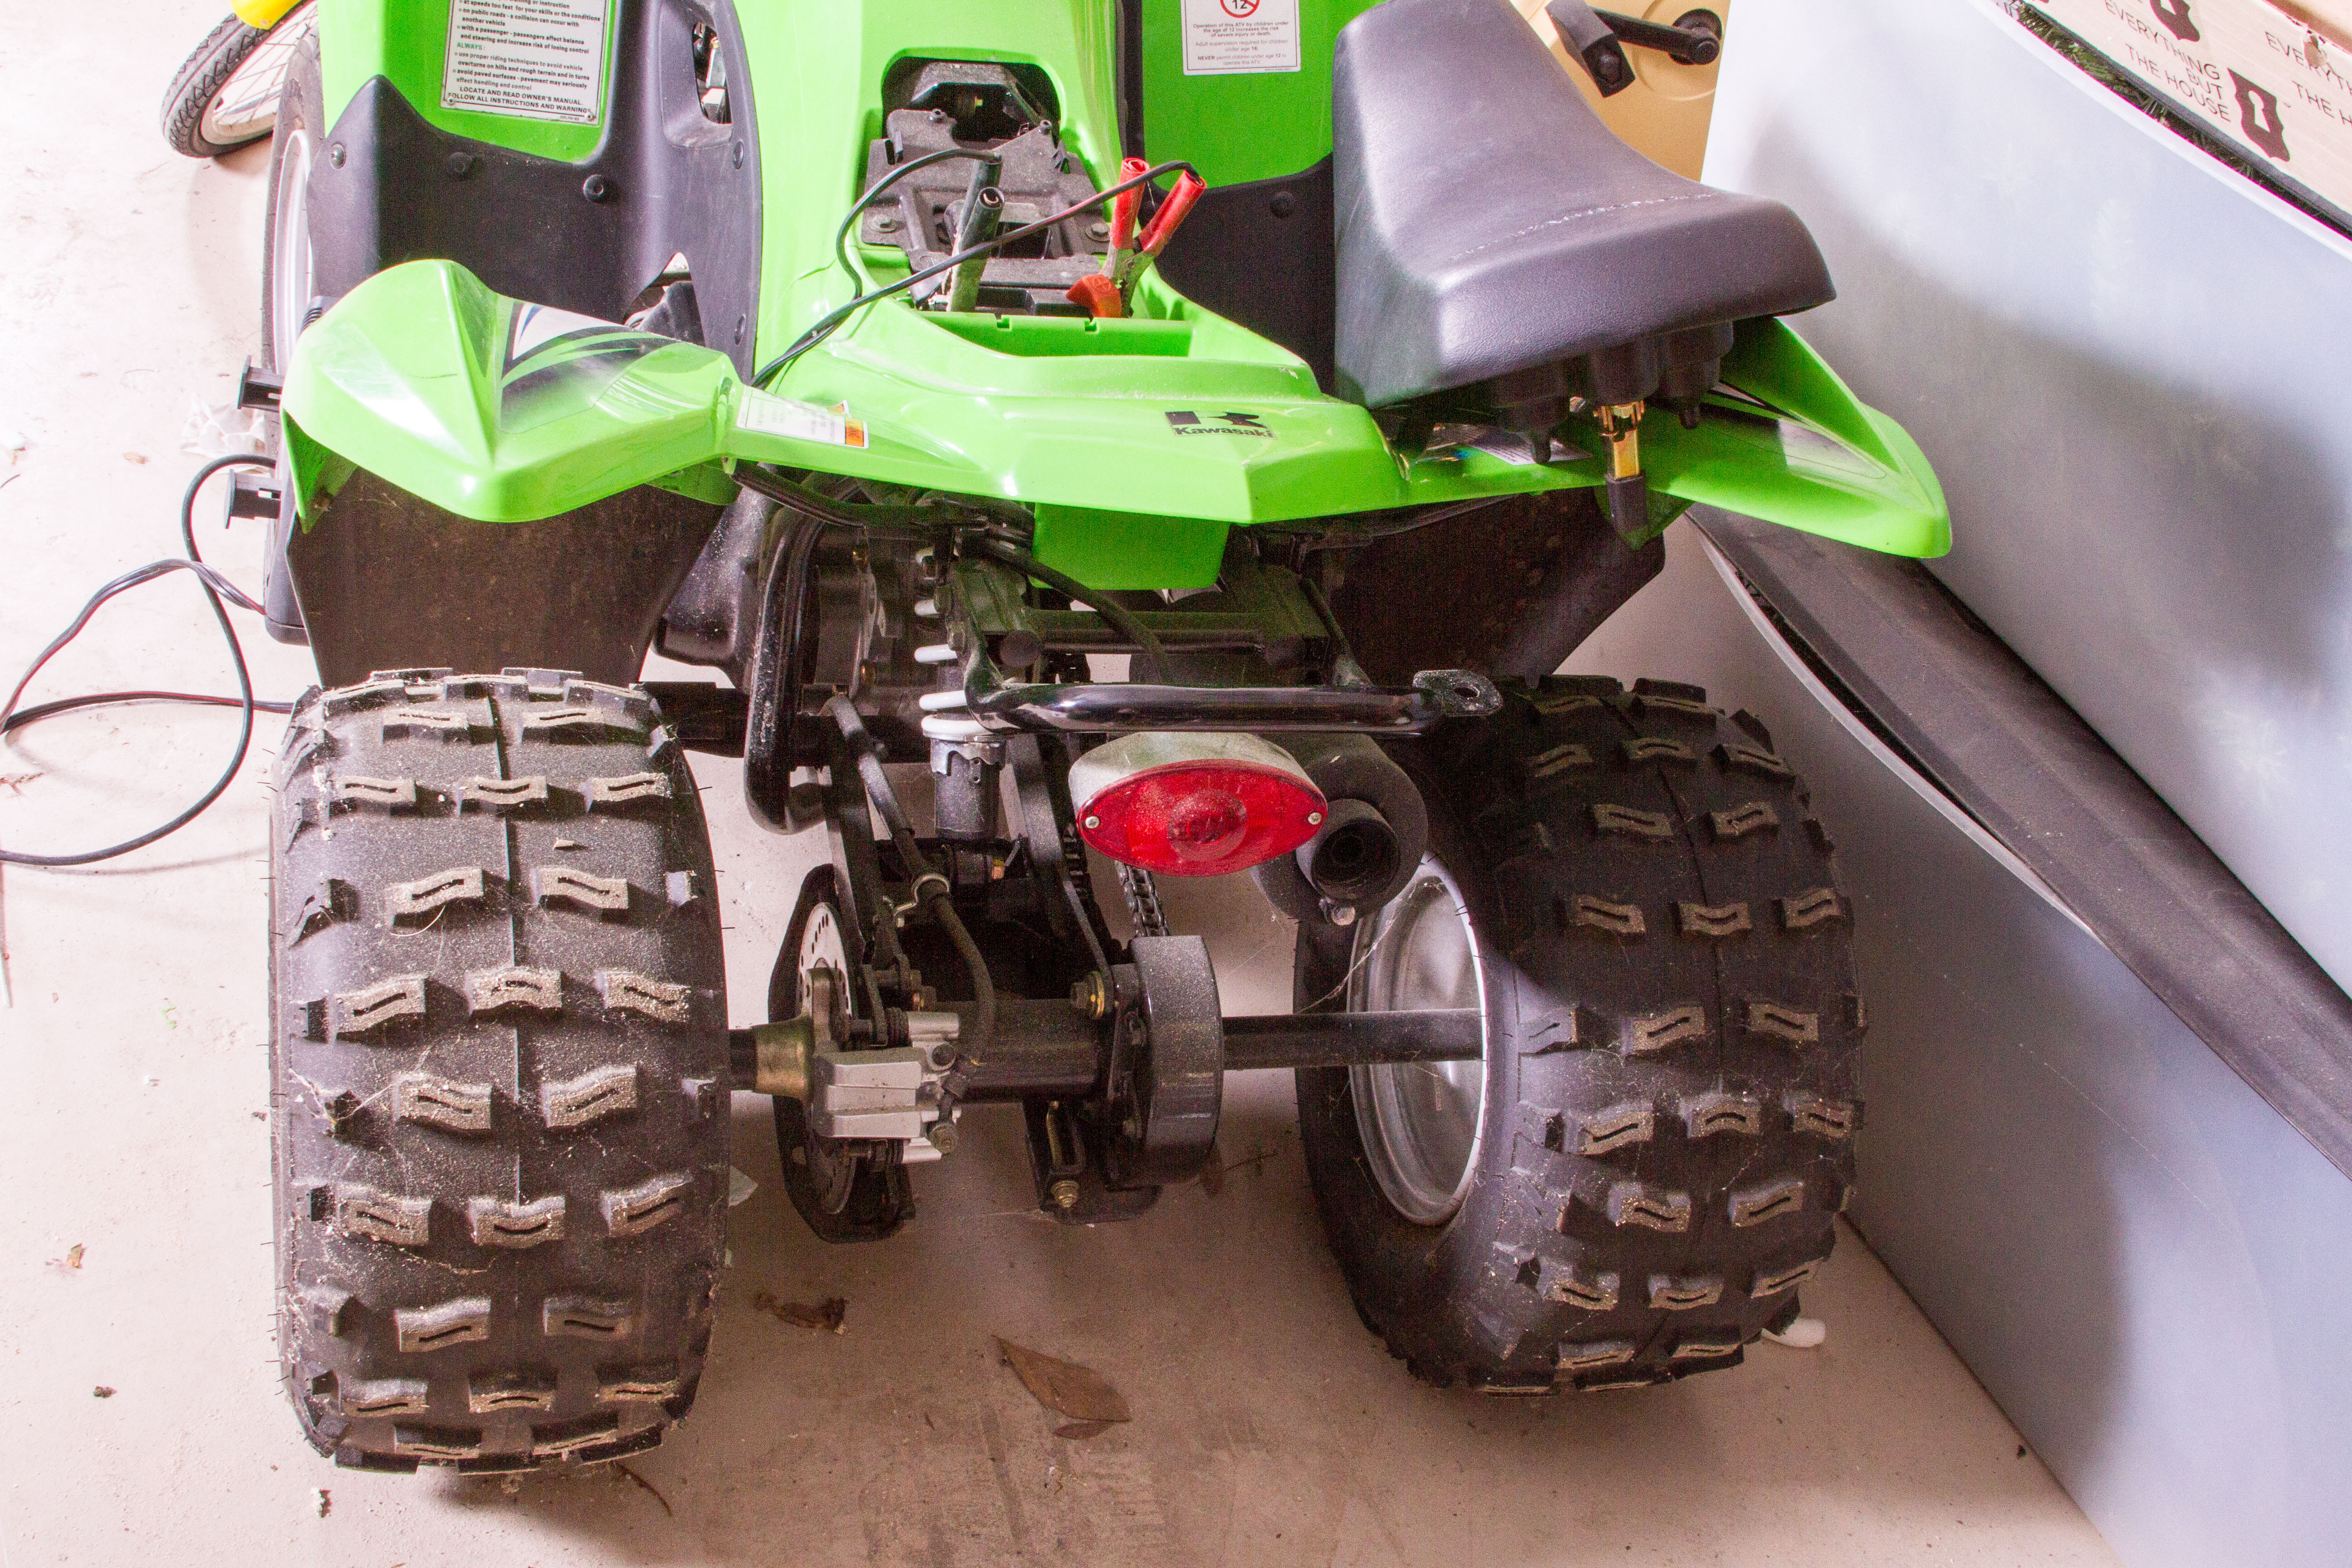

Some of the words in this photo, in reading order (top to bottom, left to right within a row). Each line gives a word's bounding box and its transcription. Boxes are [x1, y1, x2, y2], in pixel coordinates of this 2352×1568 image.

[539, 0, 570, 9] instruction
[1232, 0, 1247, 9] 12
[2105, 0, 2220, 79] EVERYTHING
[2125, 43, 2161, 79] THE
[2165, 70, 2231, 123] HOUSE
[2186, 68, 2222, 100] BUT
[490, 98, 539, 107] INSTRUCTIONS
[2292, 80, 2335, 118] THE
[1174, 427, 1274, 438] Kawasaki
